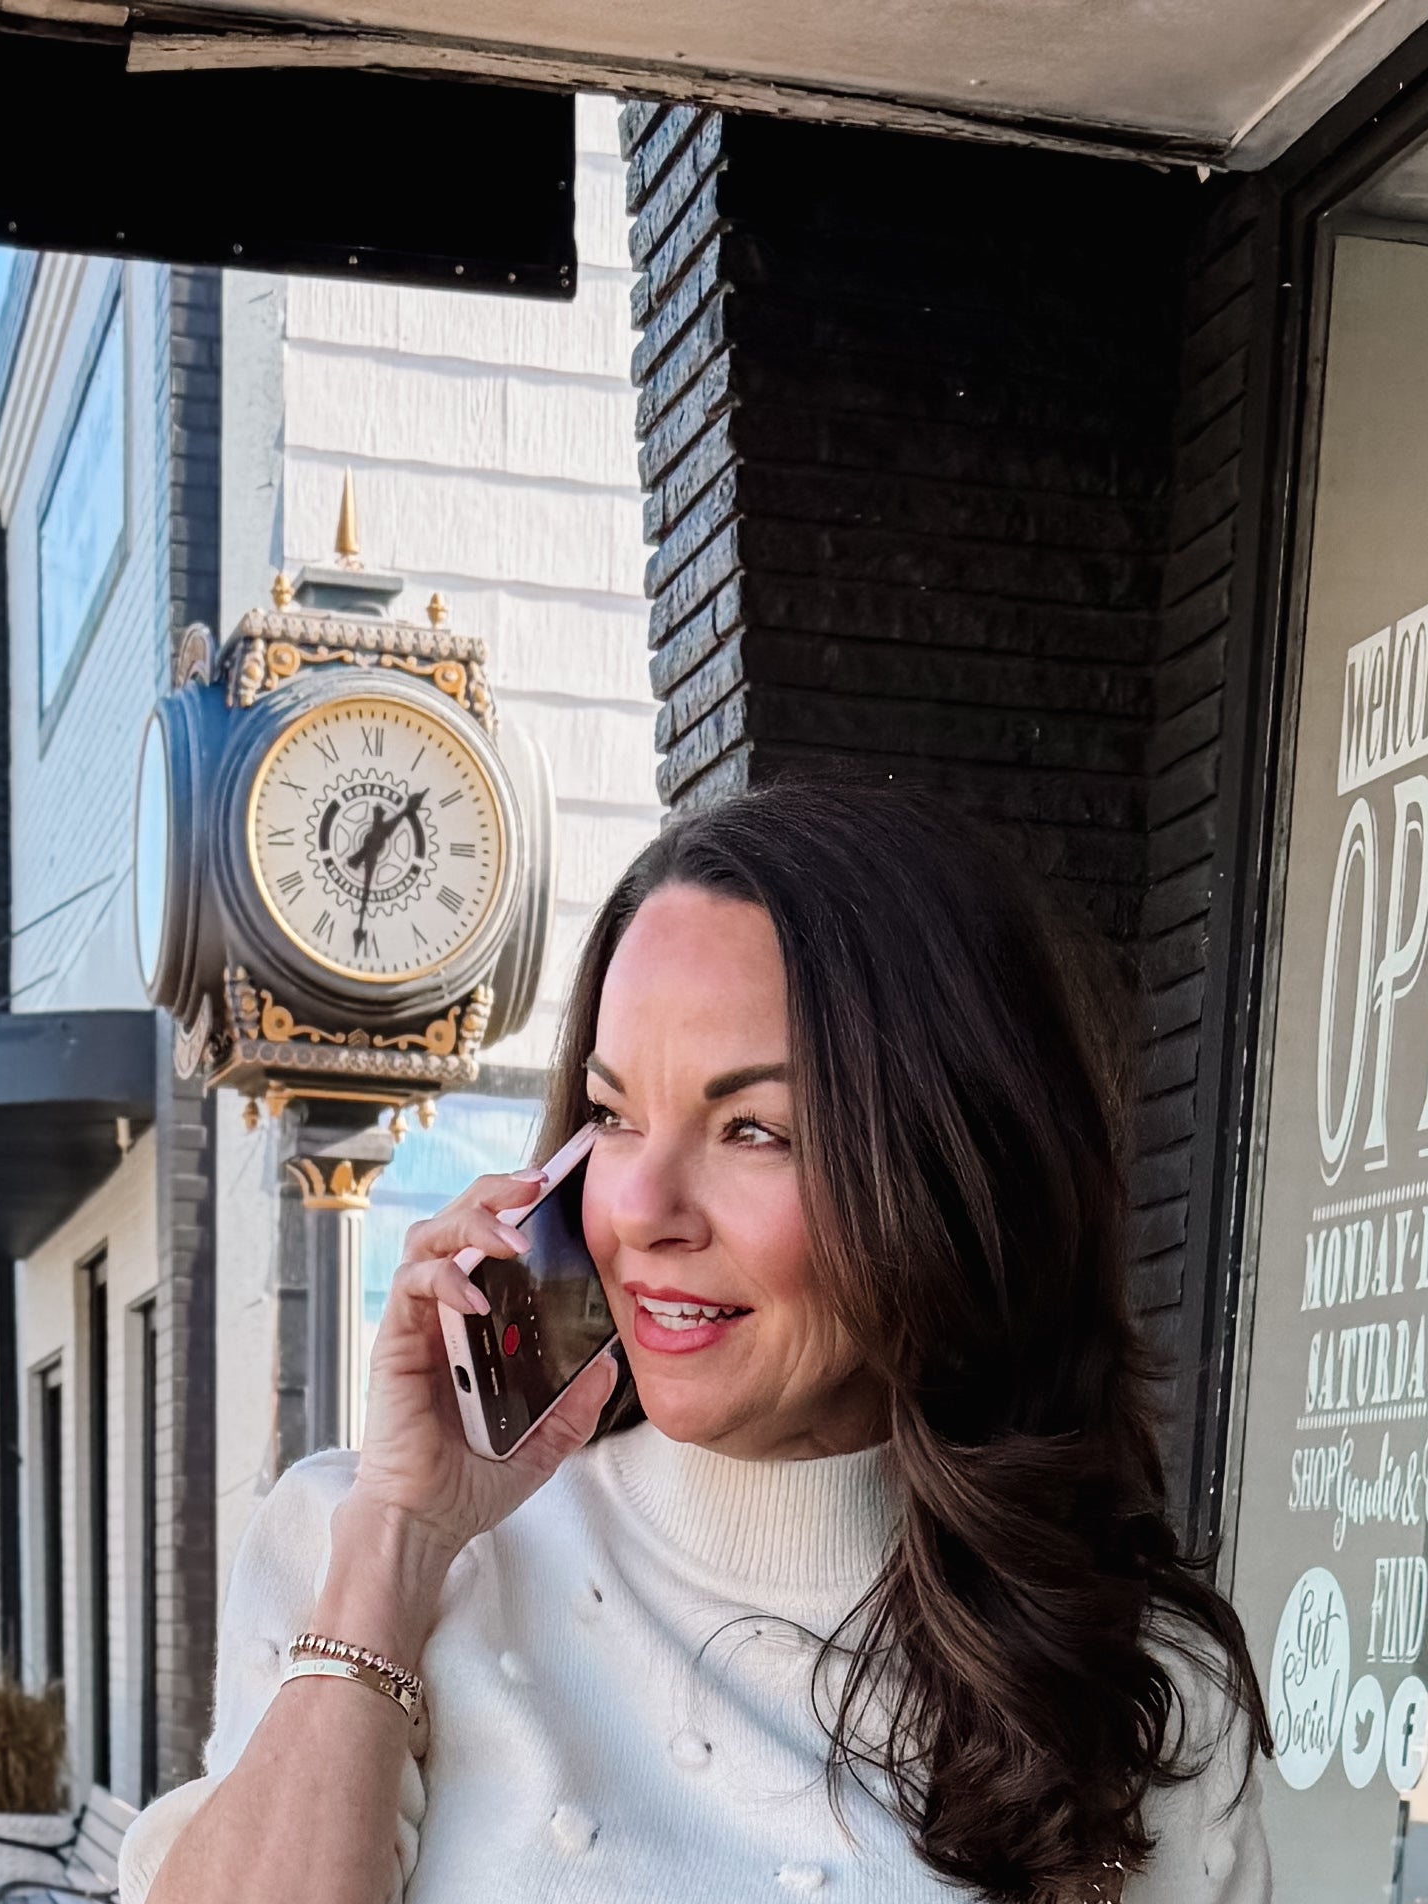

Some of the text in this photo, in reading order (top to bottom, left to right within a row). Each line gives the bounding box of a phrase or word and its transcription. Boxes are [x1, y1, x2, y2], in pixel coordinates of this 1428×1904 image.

[1297, 1580, 1341, 1687] Get
[1367, 1557, 1428, 1663] FIND
[1275, 1640, 1340, 1756] Social
